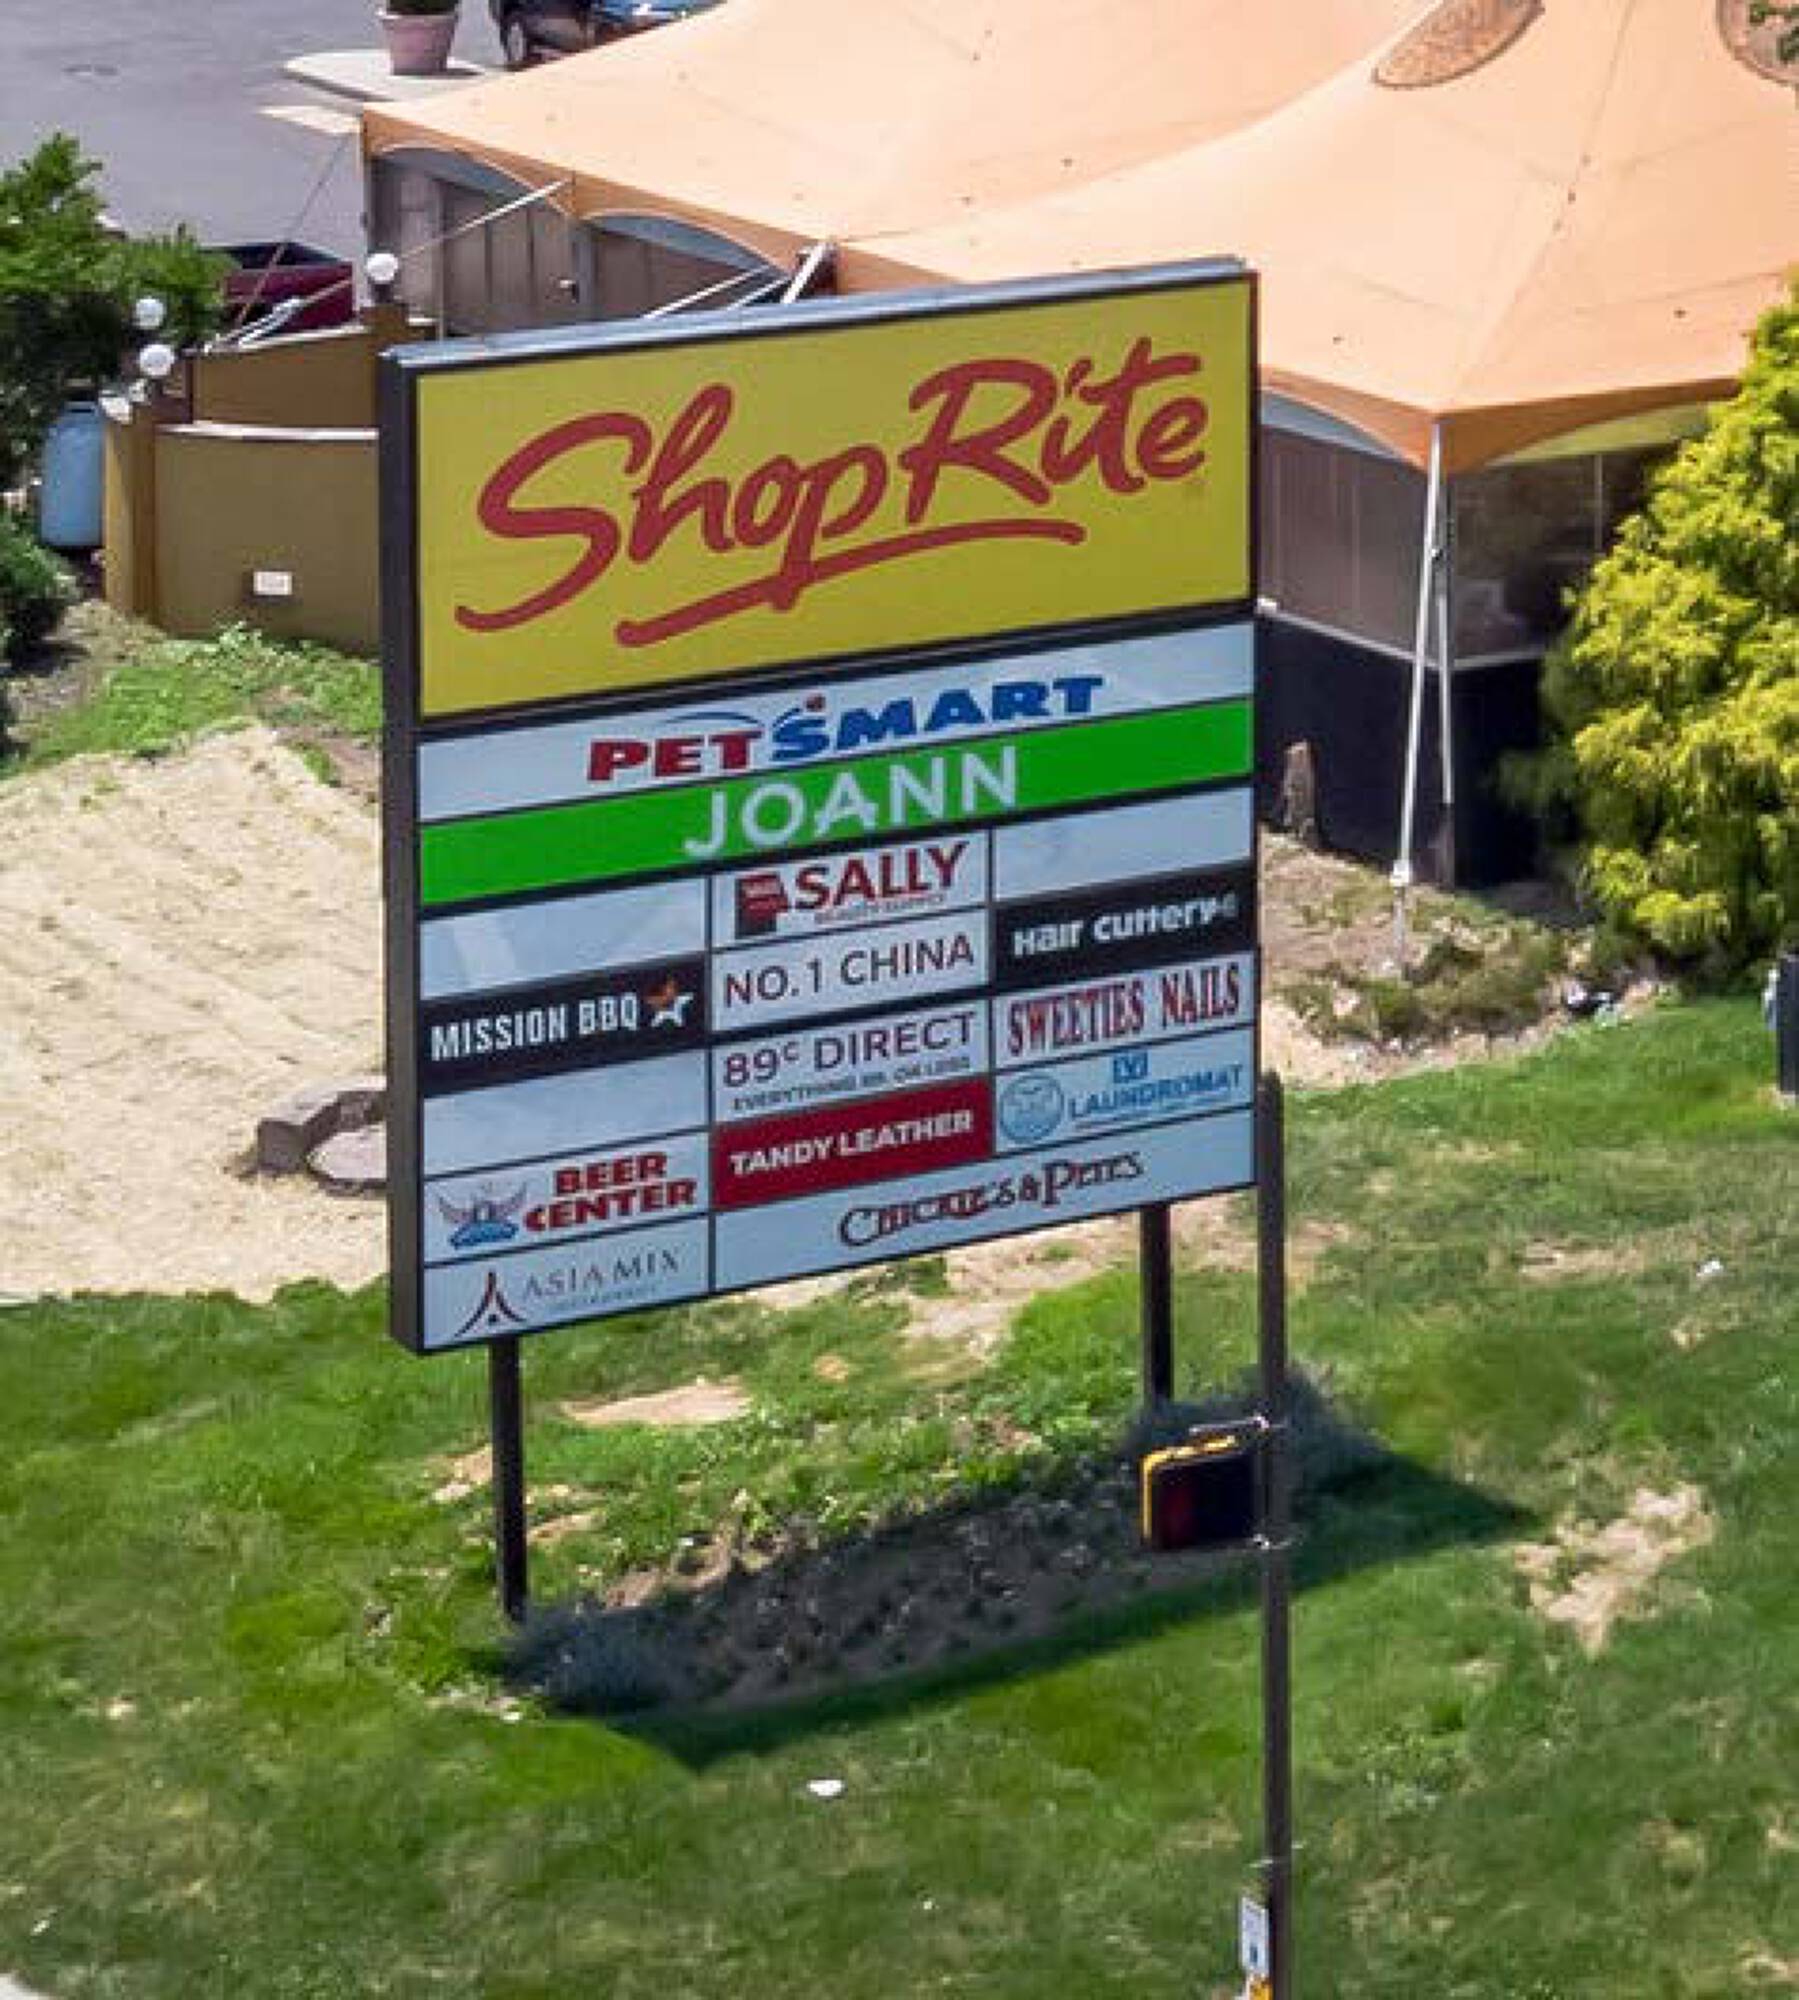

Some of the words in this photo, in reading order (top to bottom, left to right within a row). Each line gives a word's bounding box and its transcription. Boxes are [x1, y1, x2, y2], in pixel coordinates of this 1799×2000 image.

[454, 336, 1208, 632] ShopRite
[587, 677, 1103, 780] PETSMART
[684, 746, 1017, 857] JOANN
[795, 841, 970, 910] SALLY
[840, 934, 975, 985] CHINA
[431, 1003, 568, 1061] MISSION
[579, 993, 638, 1035] BBQ
[814, 1011, 976, 1071] DIRECT
[1008, 981, 1144, 1056] SWEETIES
[1162, 962, 1240, 1029] NAILS
[1071, 1064, 1244, 1118] LAUNDROMAT
[554, 1151, 668, 1195] BEER
[730, 1136, 834, 1176] TANDY
[841, 1110, 973, 1155] LEATHER
[524, 1179, 697, 1232] CENTER
[523, 1264, 603, 1301] ASIA
[613, 1247, 680, 1284] MIX
